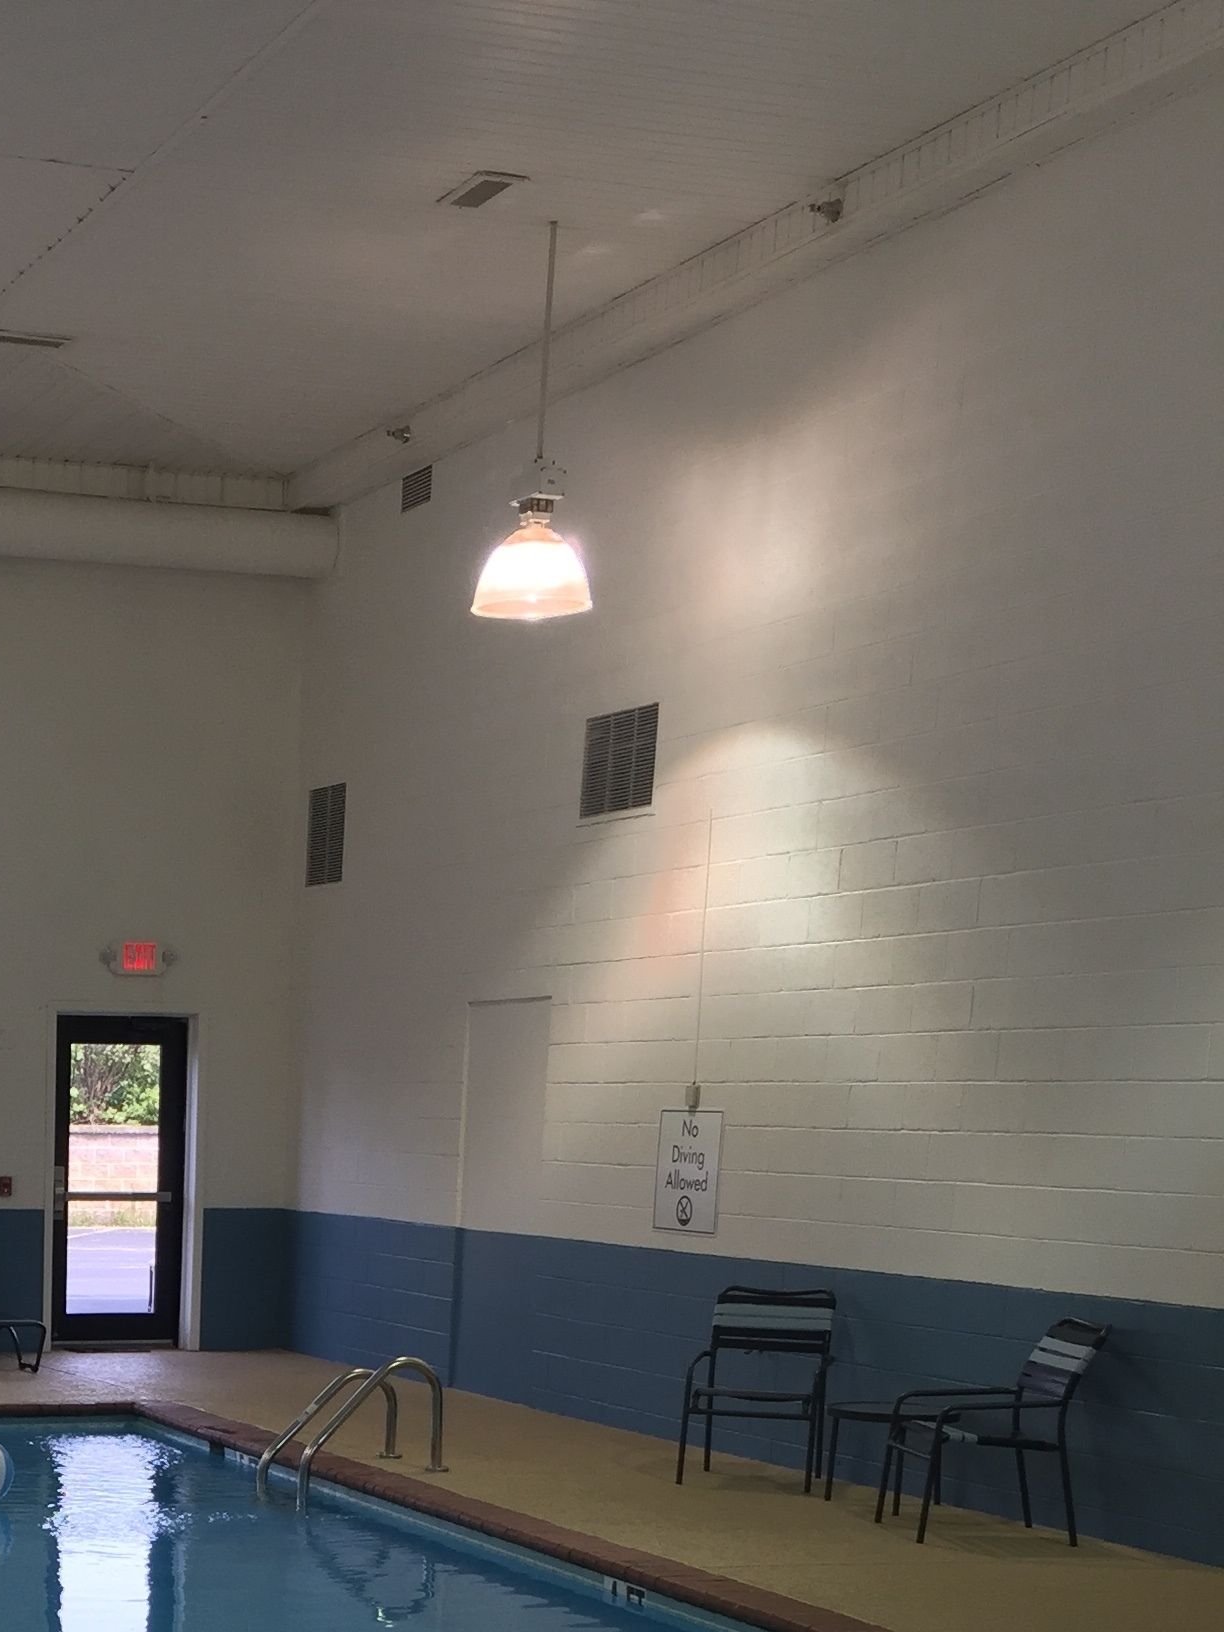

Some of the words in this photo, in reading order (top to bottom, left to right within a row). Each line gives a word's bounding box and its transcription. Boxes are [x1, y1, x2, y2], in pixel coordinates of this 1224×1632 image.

[681, 1119, 699, 1138] No
[671, 1145, 705, 1170] Diving
[665, 1169, 708, 1192] Allowed
